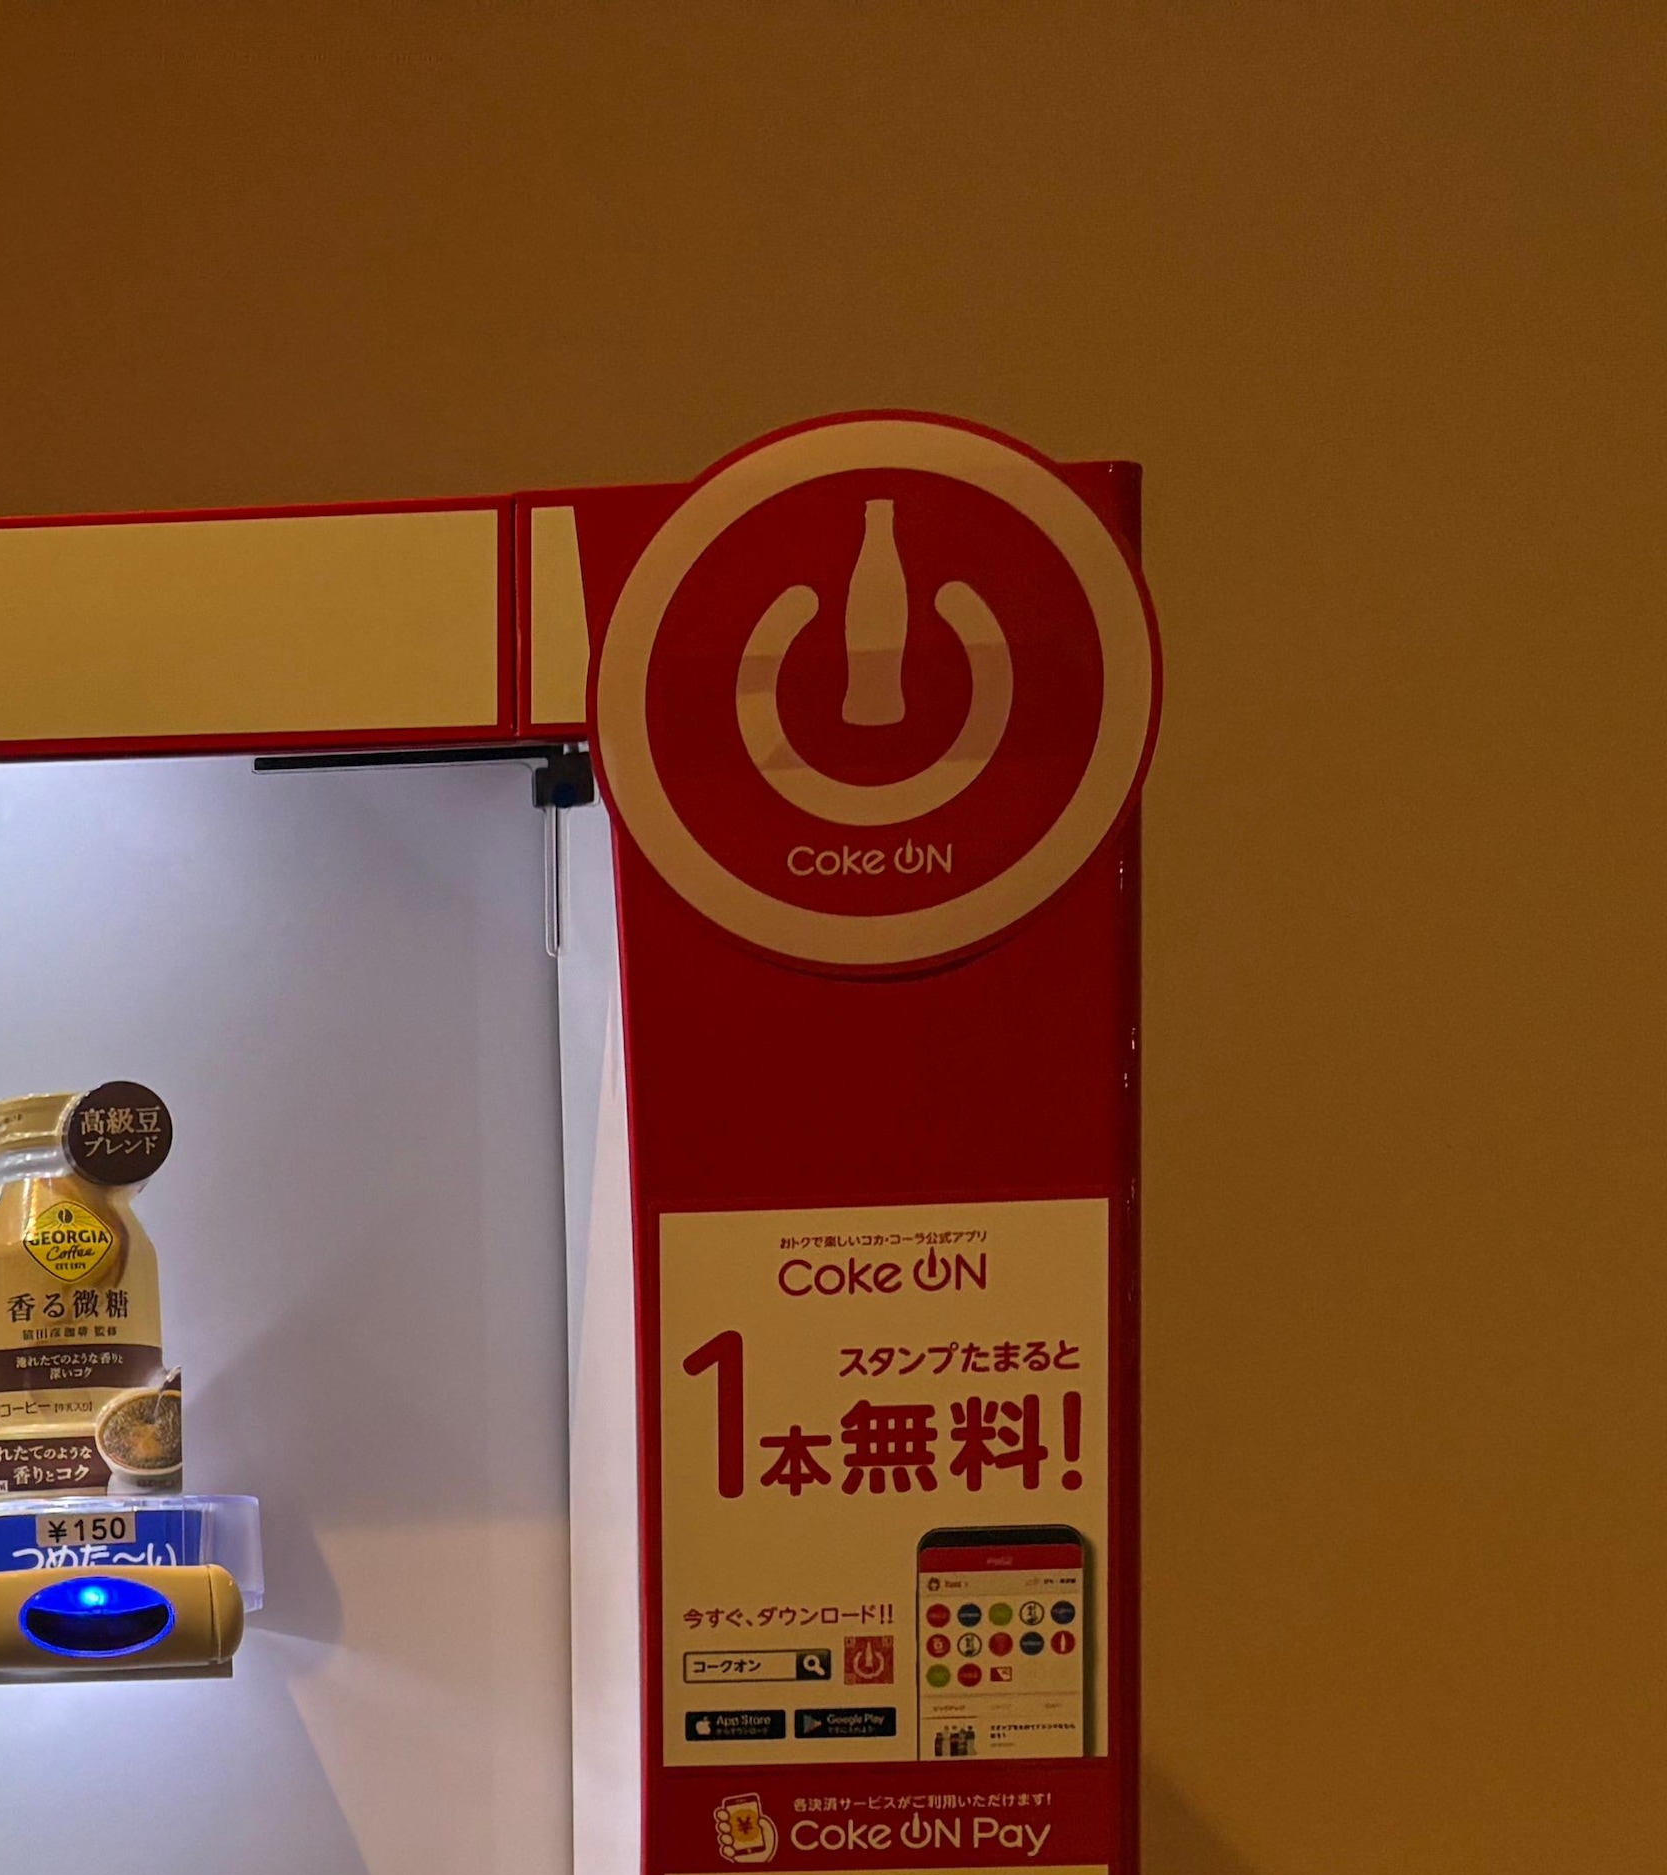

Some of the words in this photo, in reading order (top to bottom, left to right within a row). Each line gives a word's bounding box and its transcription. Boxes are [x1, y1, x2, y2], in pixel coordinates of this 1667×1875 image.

[787, 846, 885, 876] Coke
[778, 1257, 903, 1296] Coke
[7, 1288, 129, 1321] 香る微糖
[839, 1340, 1081, 1377] スタンプたまると
[47, 1518, 128, 1542] ¥150
[683, 1604, 894, 1629] 今すぐ、ダウンロード!!
[692, 1659, 761, 1673] コークオン
[716, 1715, 737, 1727] App
[740, 1714, 771, 1726] Store
[791, 1818, 892, 1851] Coke
[973, 1817, 1051, 1857] Pay
